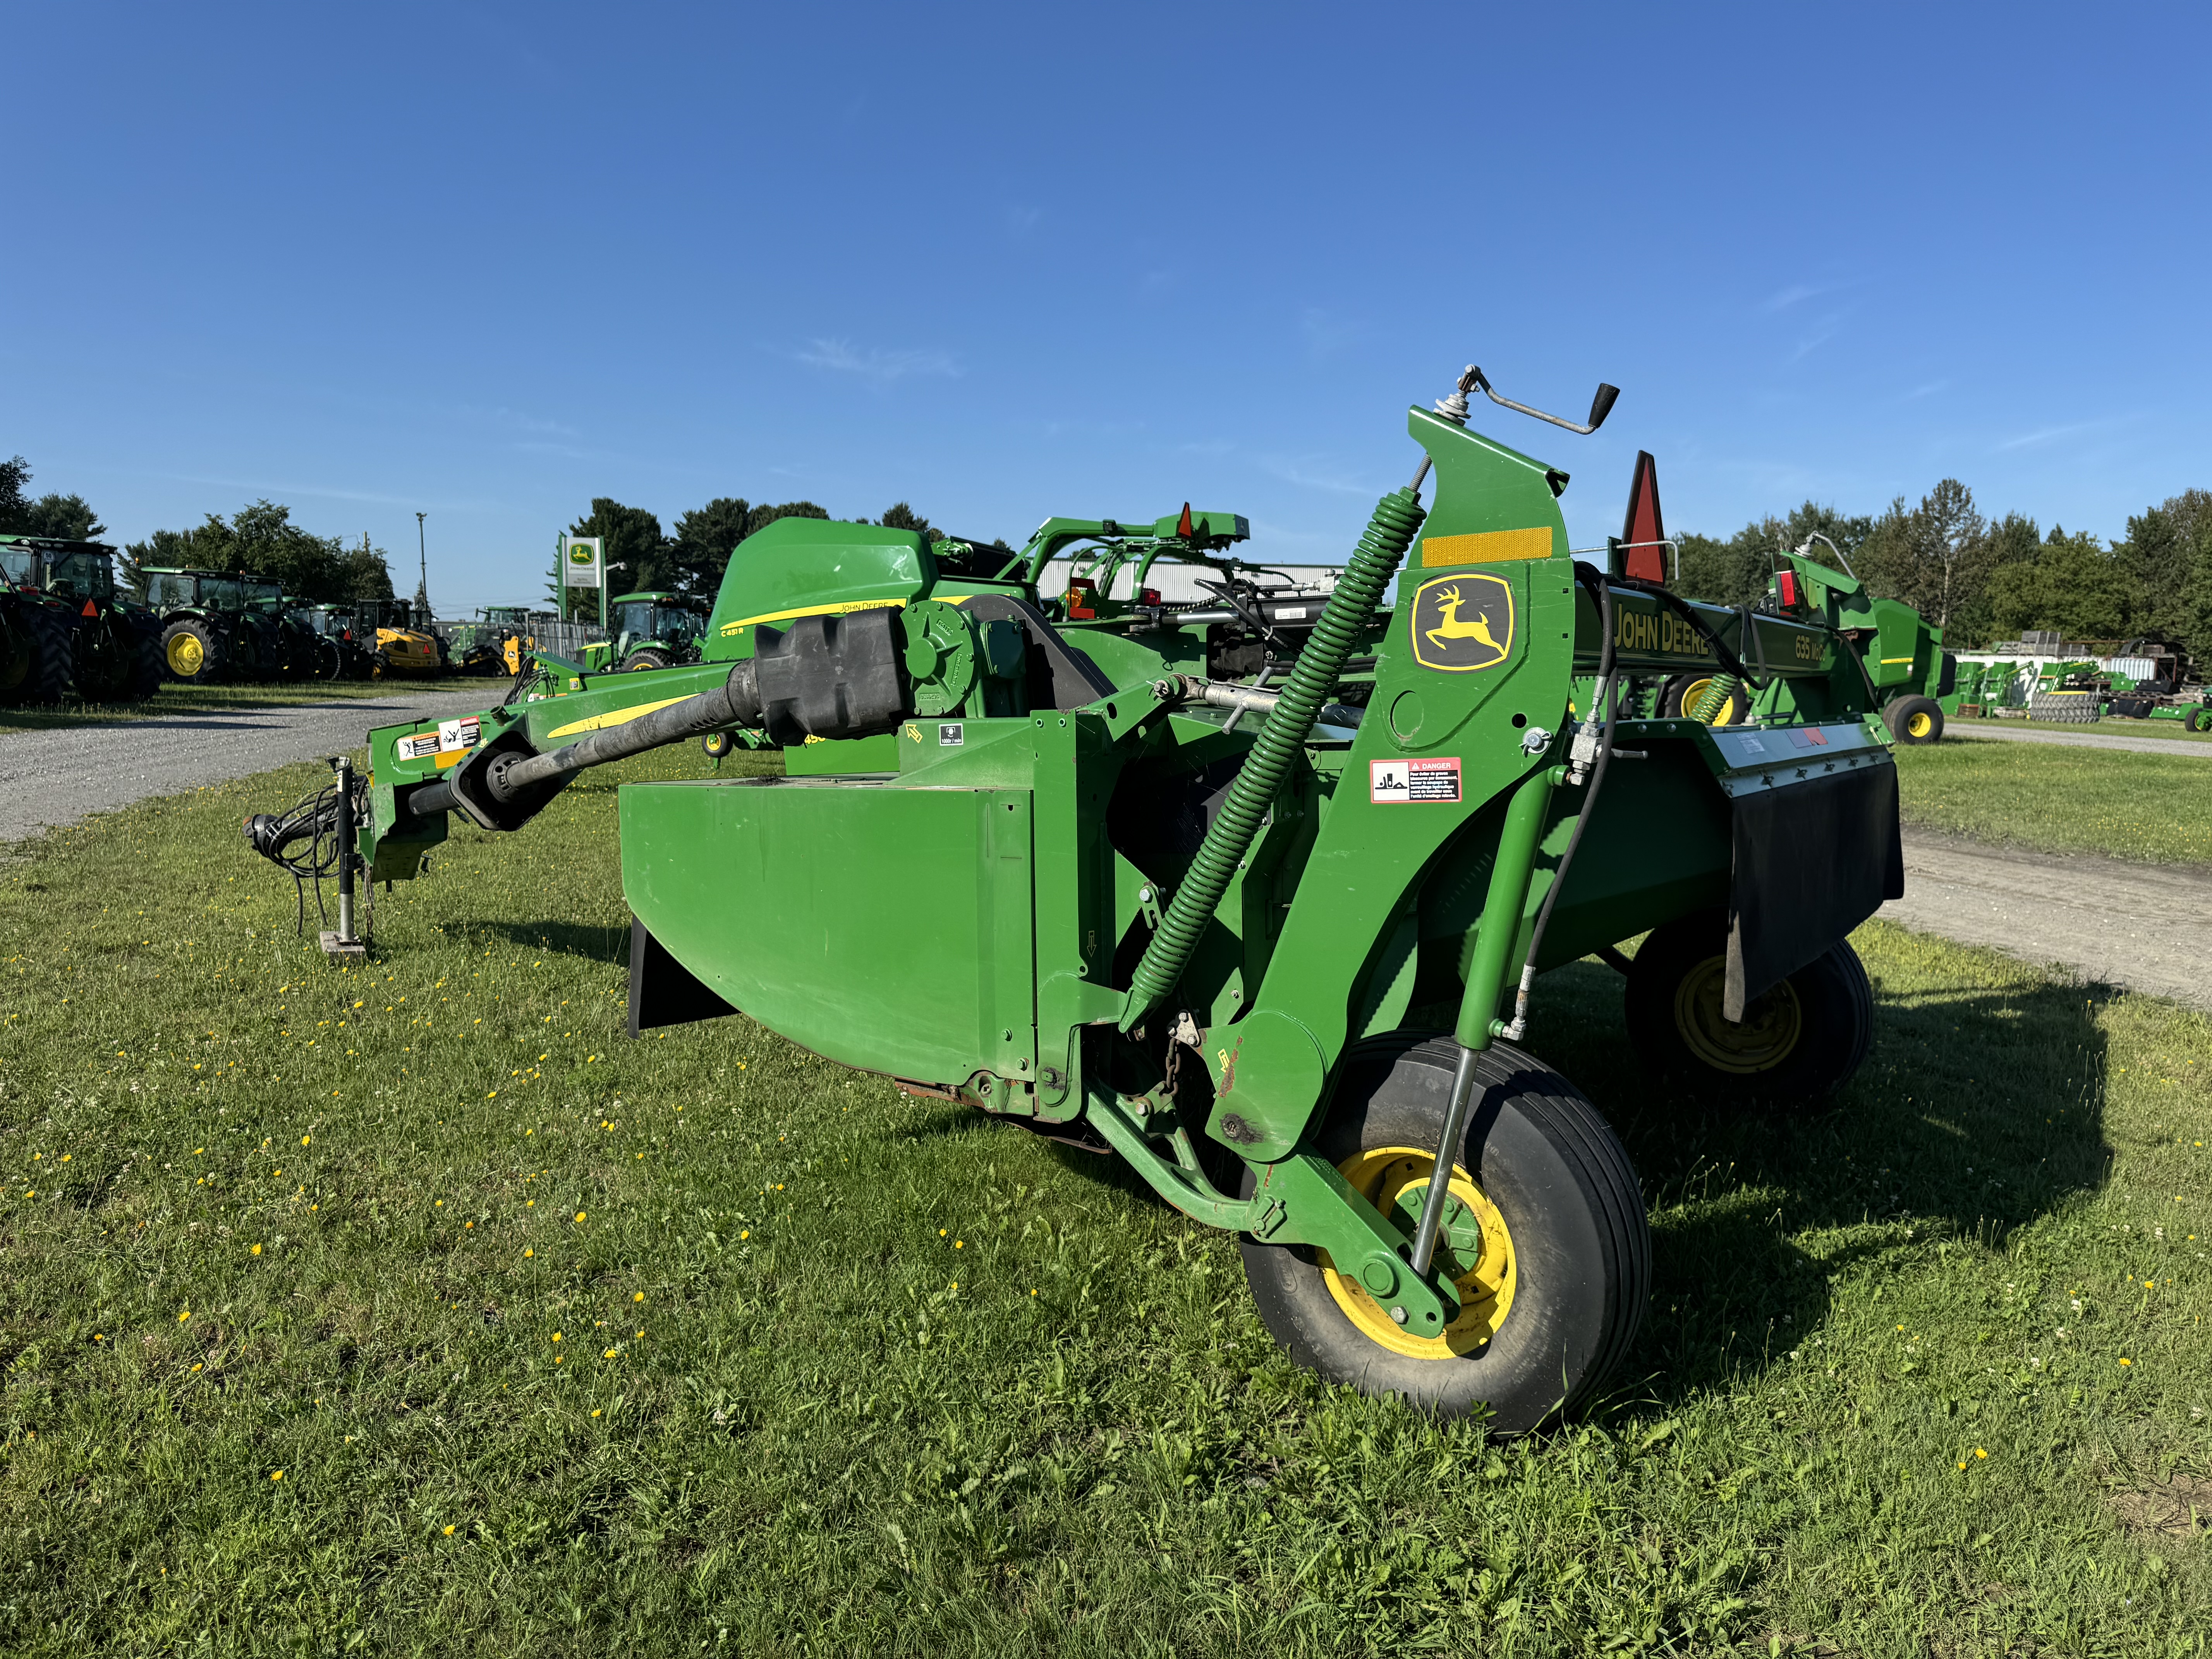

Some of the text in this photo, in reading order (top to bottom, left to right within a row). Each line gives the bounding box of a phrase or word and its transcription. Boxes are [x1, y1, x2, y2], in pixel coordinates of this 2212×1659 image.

[1614, 603, 1658, 650] JOHN
[1796, 635, 1826, 661] 635 MoCo
